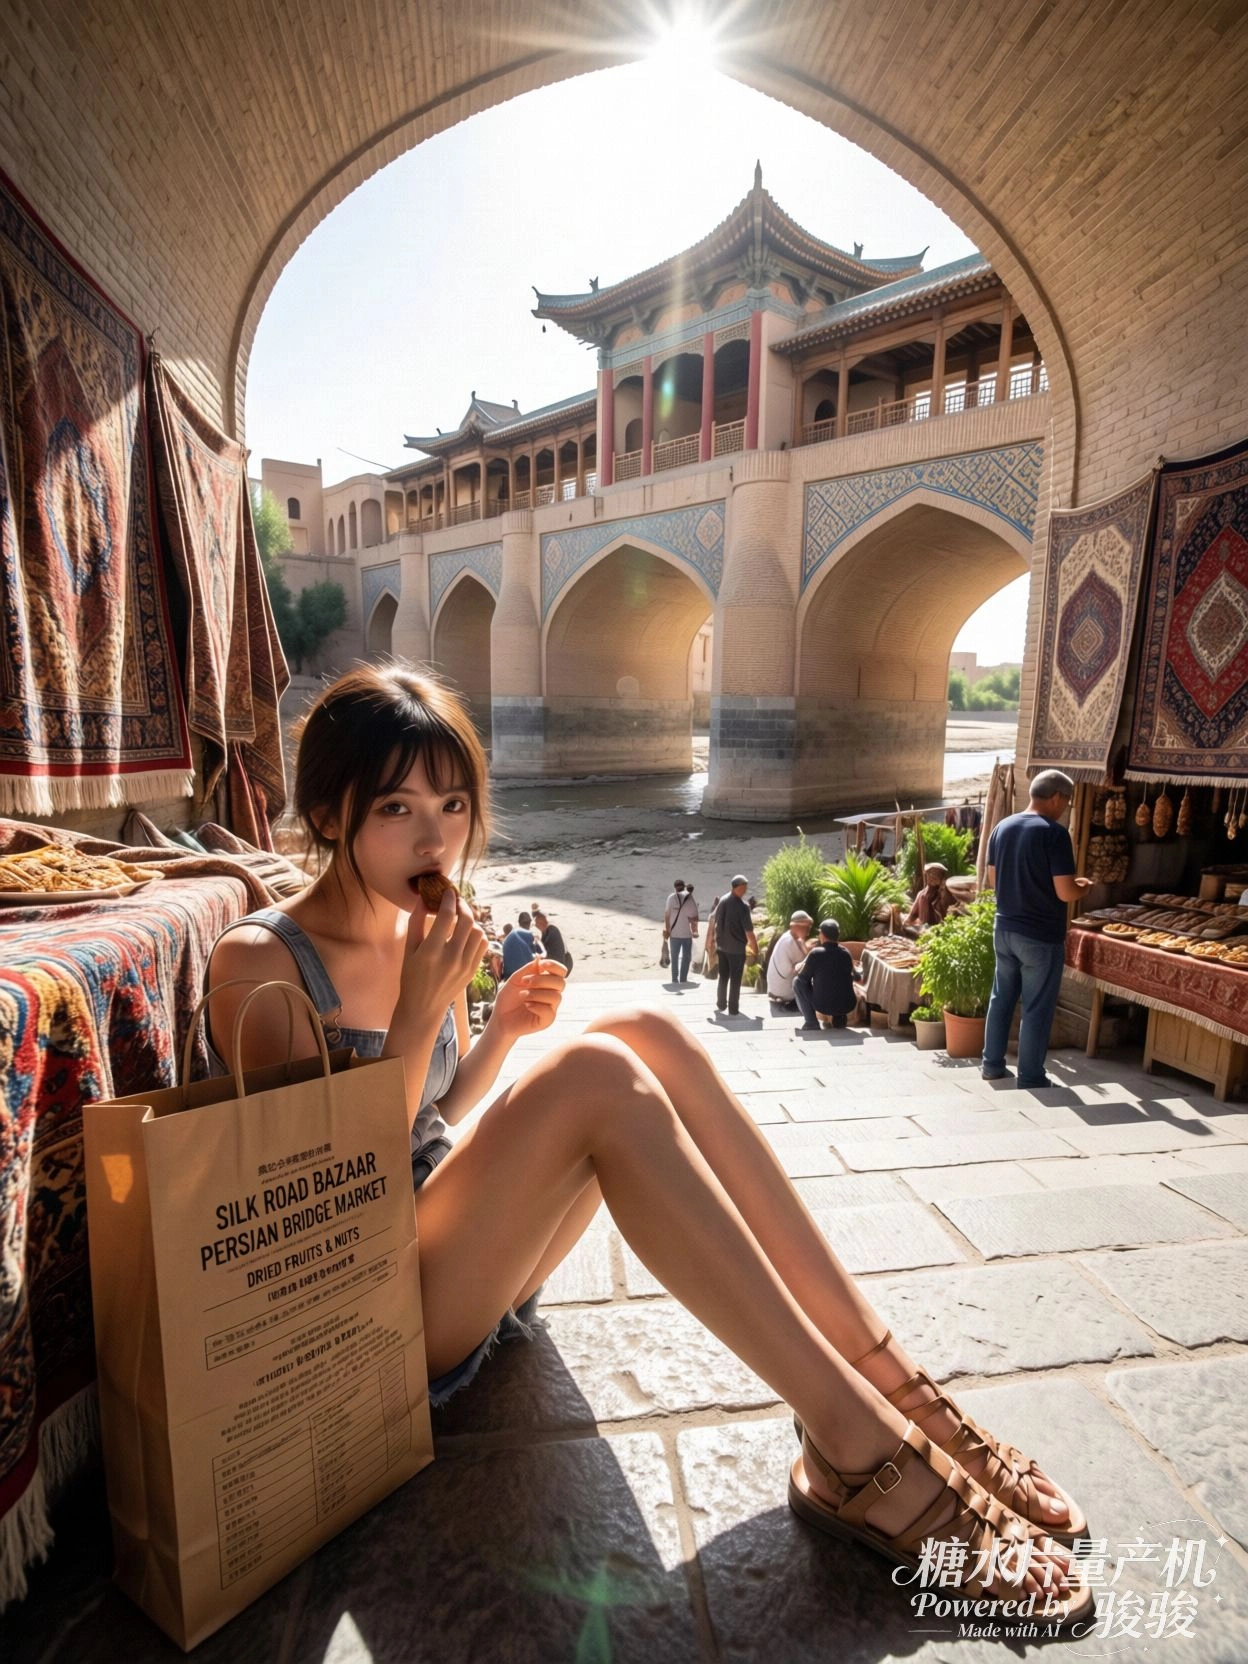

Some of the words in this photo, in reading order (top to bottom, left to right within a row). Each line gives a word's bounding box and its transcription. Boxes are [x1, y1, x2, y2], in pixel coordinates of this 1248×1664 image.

[200, 1226, 279, 1271] PERSIAN
[283, 1199, 333, 1239] BRIDGE
[335, 1176, 388, 1214] MARKET
[215, 1196, 260, 1230] SILK
[264, 1177, 309, 1211] ROAD
[313, 1152, 377, 1196] BAZAAR
[247, 1260, 282, 1288] DRIED
[285, 1241, 323, 1274] FRUITS
[325, 1239, 333, 1253] &
[335, 1227, 360, 1249] NUTS
